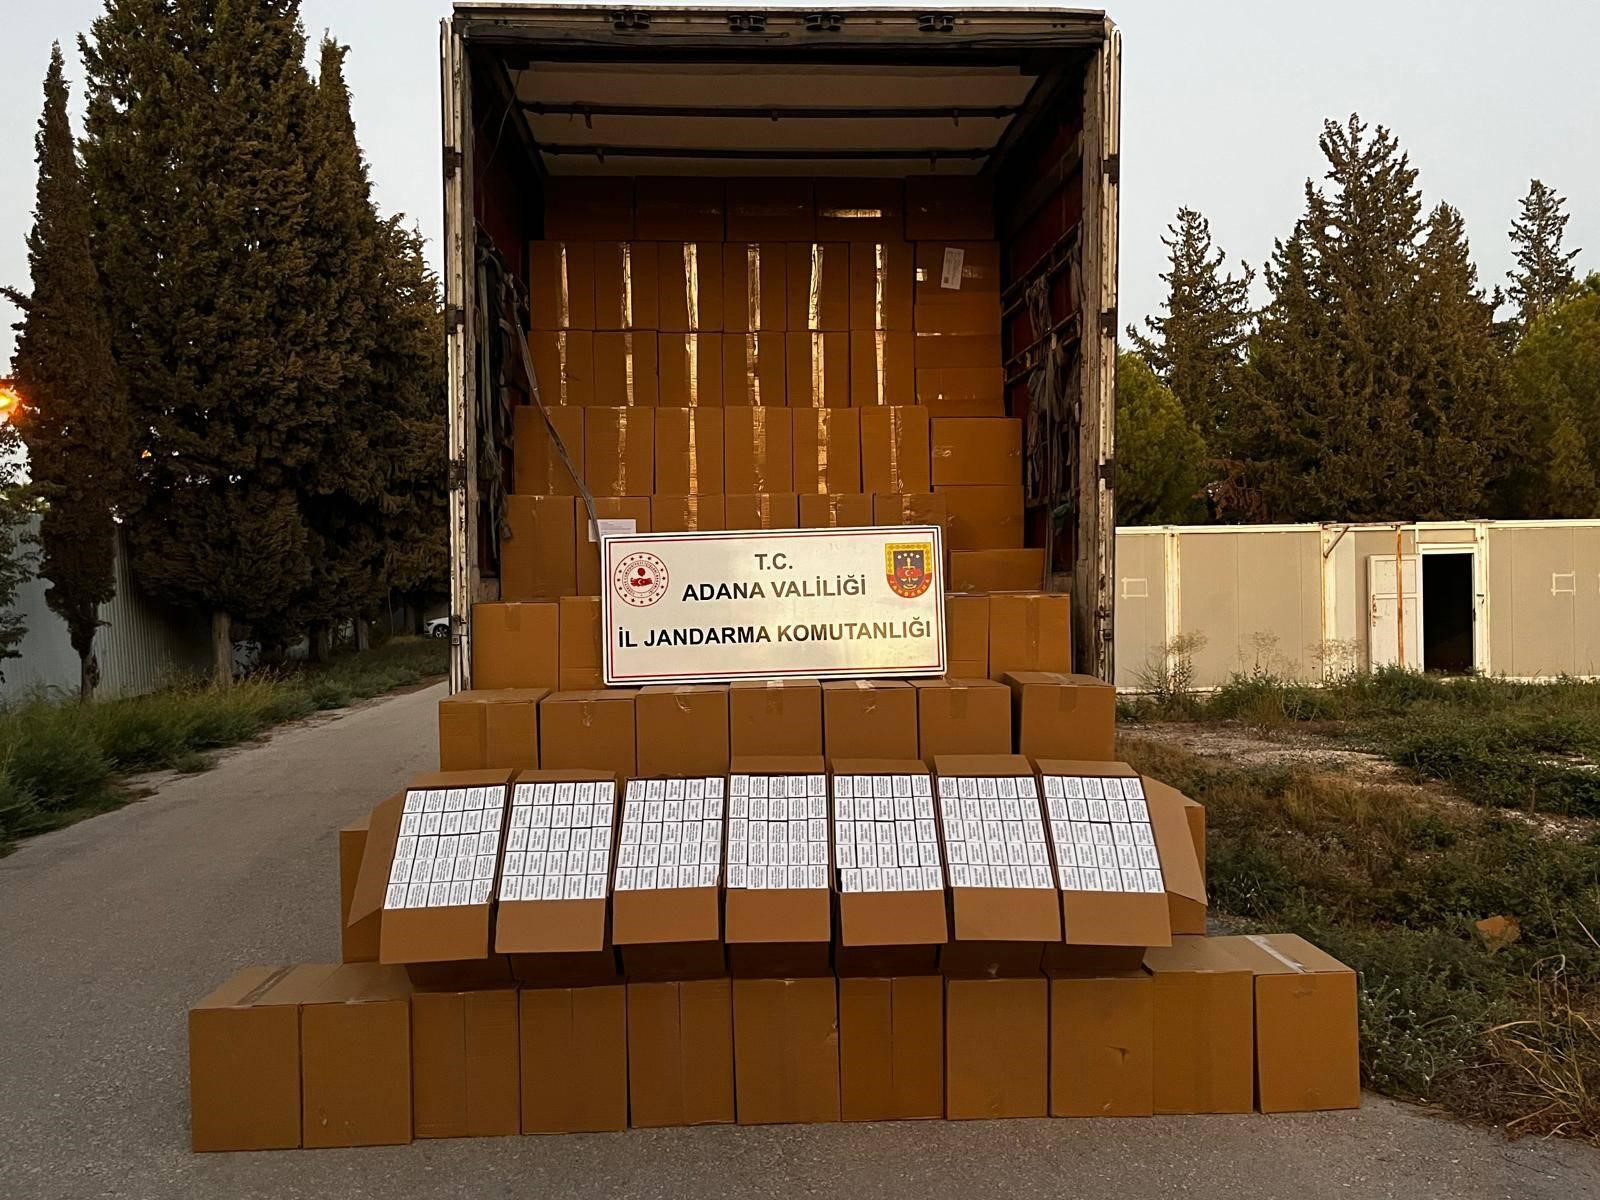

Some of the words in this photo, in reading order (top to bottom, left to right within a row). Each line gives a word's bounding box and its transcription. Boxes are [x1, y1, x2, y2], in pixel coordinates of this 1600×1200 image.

[754, 553, 794, 571] T.C.
[682, 581, 766, 601] ADANA
[771, 574, 866, 599] VALİLİĞİ
[618, 626, 638, 648] İL
[644, 625, 771, 647] JANDARMA
[777, 617, 931, 642] KOMUTANLIĞI
